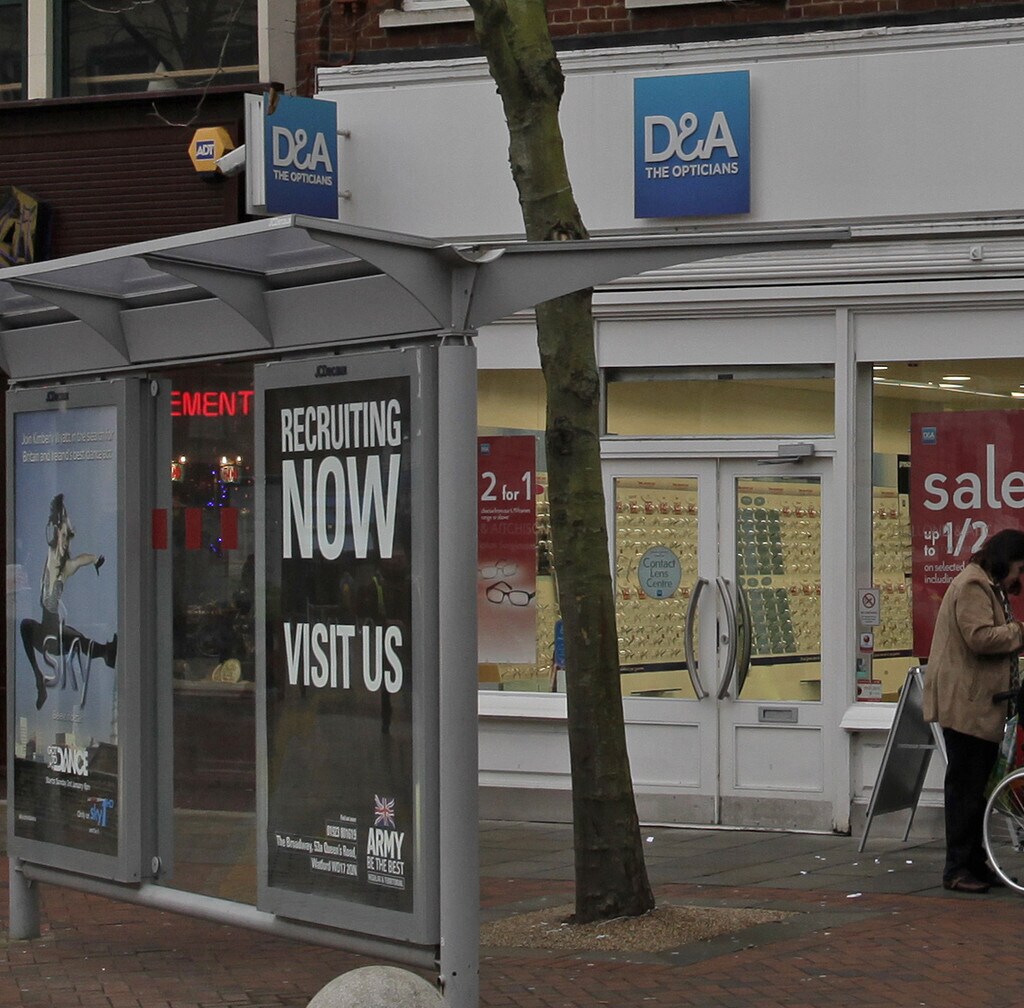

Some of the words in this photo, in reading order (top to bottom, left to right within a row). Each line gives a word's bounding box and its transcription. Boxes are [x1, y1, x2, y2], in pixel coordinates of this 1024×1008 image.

[644, 111, 739, 163] D&A
[195, 143, 215, 157] ADT
[272, 125, 334, 173] D&A
[273, 169, 289, 181] THE
[290, 172, 333, 186] OPTICIANS
[645, 166, 670, 179] THE
[672, 162, 739, 177] OPTICIANS
[170, 390, 255, 417] EMENT
[281, 398, 401, 453] RECRUITING
[480, 471, 498, 502] 2
[502, 484, 520, 502] for
[521, 471, 532, 502] 1
[281, 453, 401, 561] NOW
[924, 529, 940, 545] up
[943, 517, 990, 557] 1/2
[924, 545, 936, 557] to
[642, 557, 677, 569] Contact
[924, 564, 935, 572] on
[935, 561, 966, 572] selected
[650, 568, 670, 578] Lens
[924, 573, 955, 584] includin
[646, 578, 673, 588] Centre
[283, 622, 355, 690] VISIT
[362, 625, 403, 694] US
[276, 834, 286, 848] The
[366, 827, 405, 861] ARMY
[367, 855, 376, 870] BE
[376, 857, 387, 873] THE
[387, 859, 405, 875] BEST
